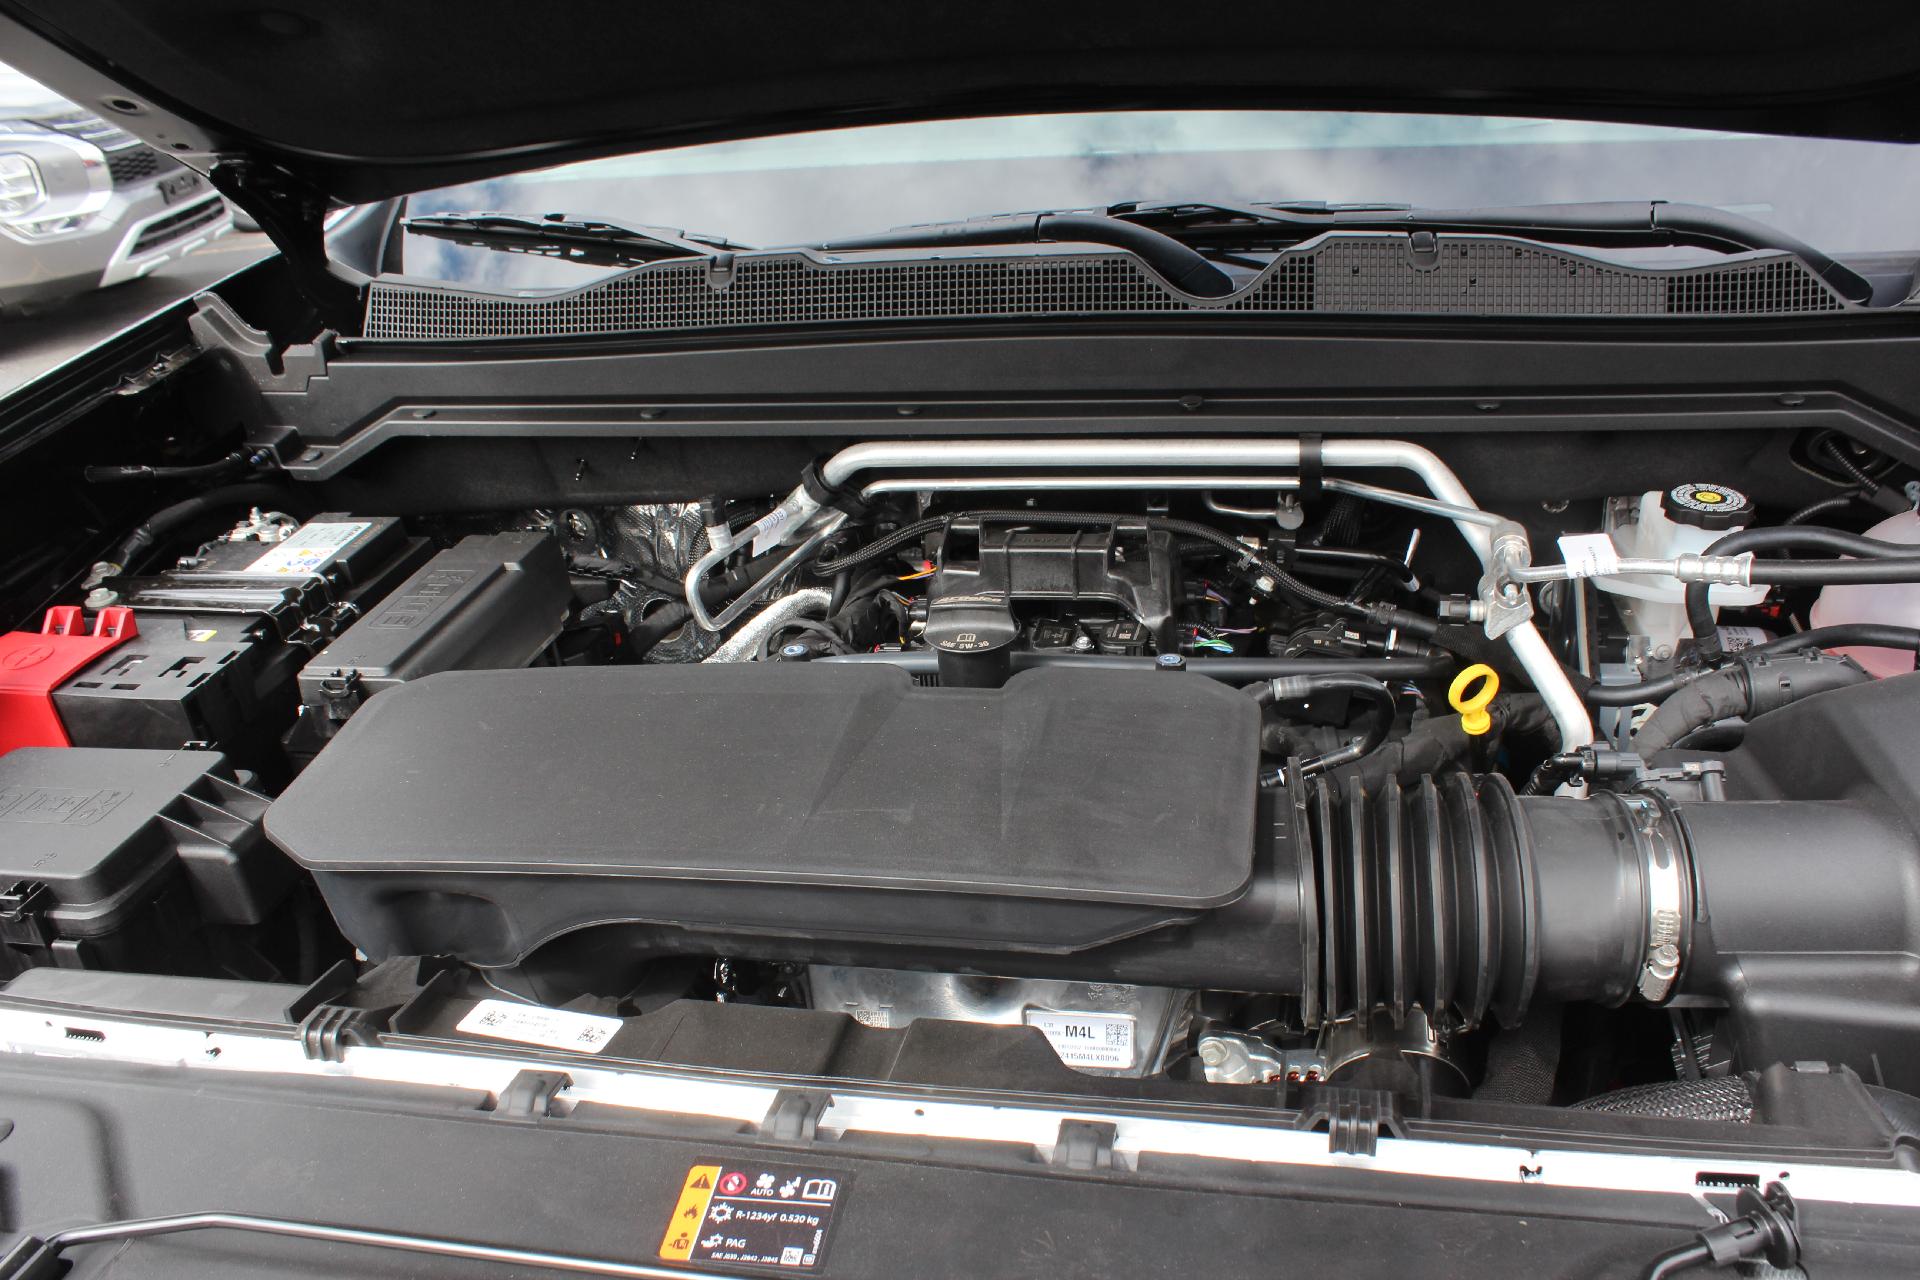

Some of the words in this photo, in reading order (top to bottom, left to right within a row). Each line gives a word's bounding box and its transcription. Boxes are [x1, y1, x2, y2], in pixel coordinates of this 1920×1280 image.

[940, 640, 956, 648] SAE
[959, 640, 990, 649] 5W-30
[1065, 1025, 1095, 1039] M4L
[751, 1187, 774, 1196] AUTO
[735, 1210, 778, 1222] R-1234yf
[780, 1213, 805, 1224] 0.520
[806, 1215, 820, 1226] kg
[725, 1238, 746, 1248] PAG
